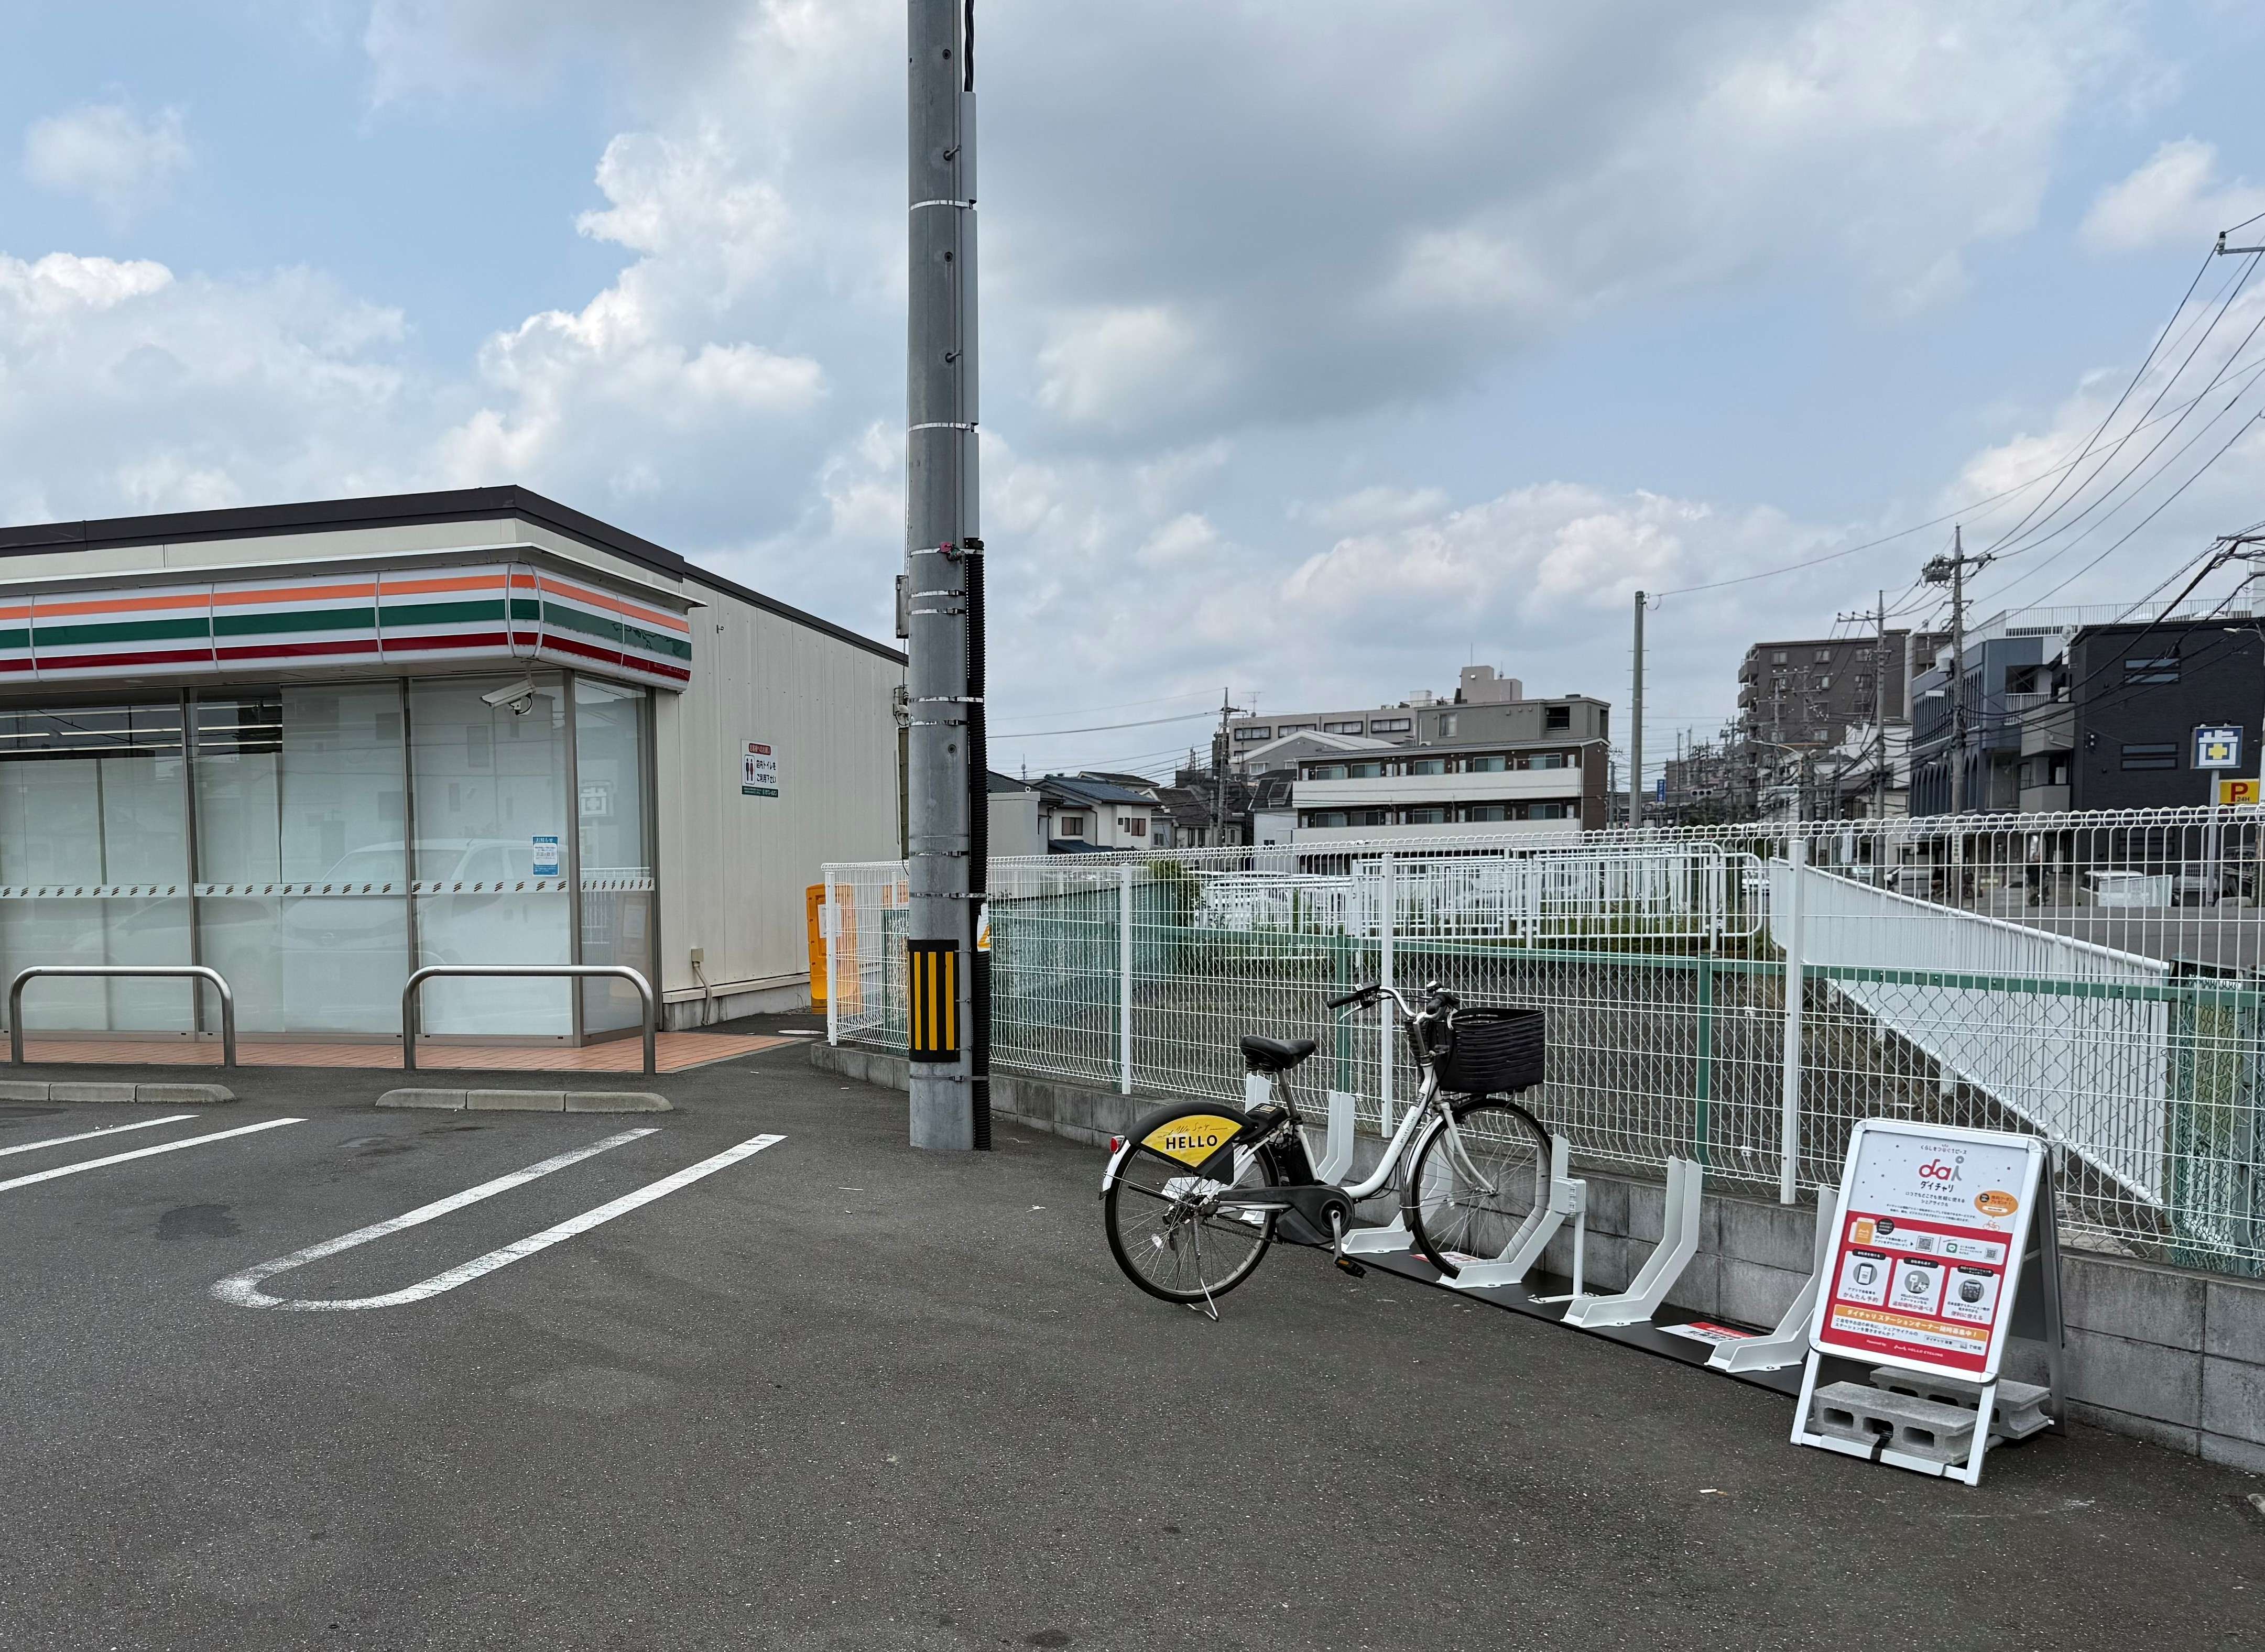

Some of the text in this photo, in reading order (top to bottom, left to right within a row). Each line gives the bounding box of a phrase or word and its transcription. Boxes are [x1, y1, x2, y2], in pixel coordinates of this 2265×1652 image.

[2231, 782, 2248, 802] P
[1166, 1134, 1218, 1150] HELLO
[1920, 1181, 1954, 1192] ダイチャリ
[1921, 1199, 1948, 1207] シェアサイクル
[1843, 1292, 1879, 1303] かんたん予約
[1846, 1309, 1877, 1319] ダイチャリ
